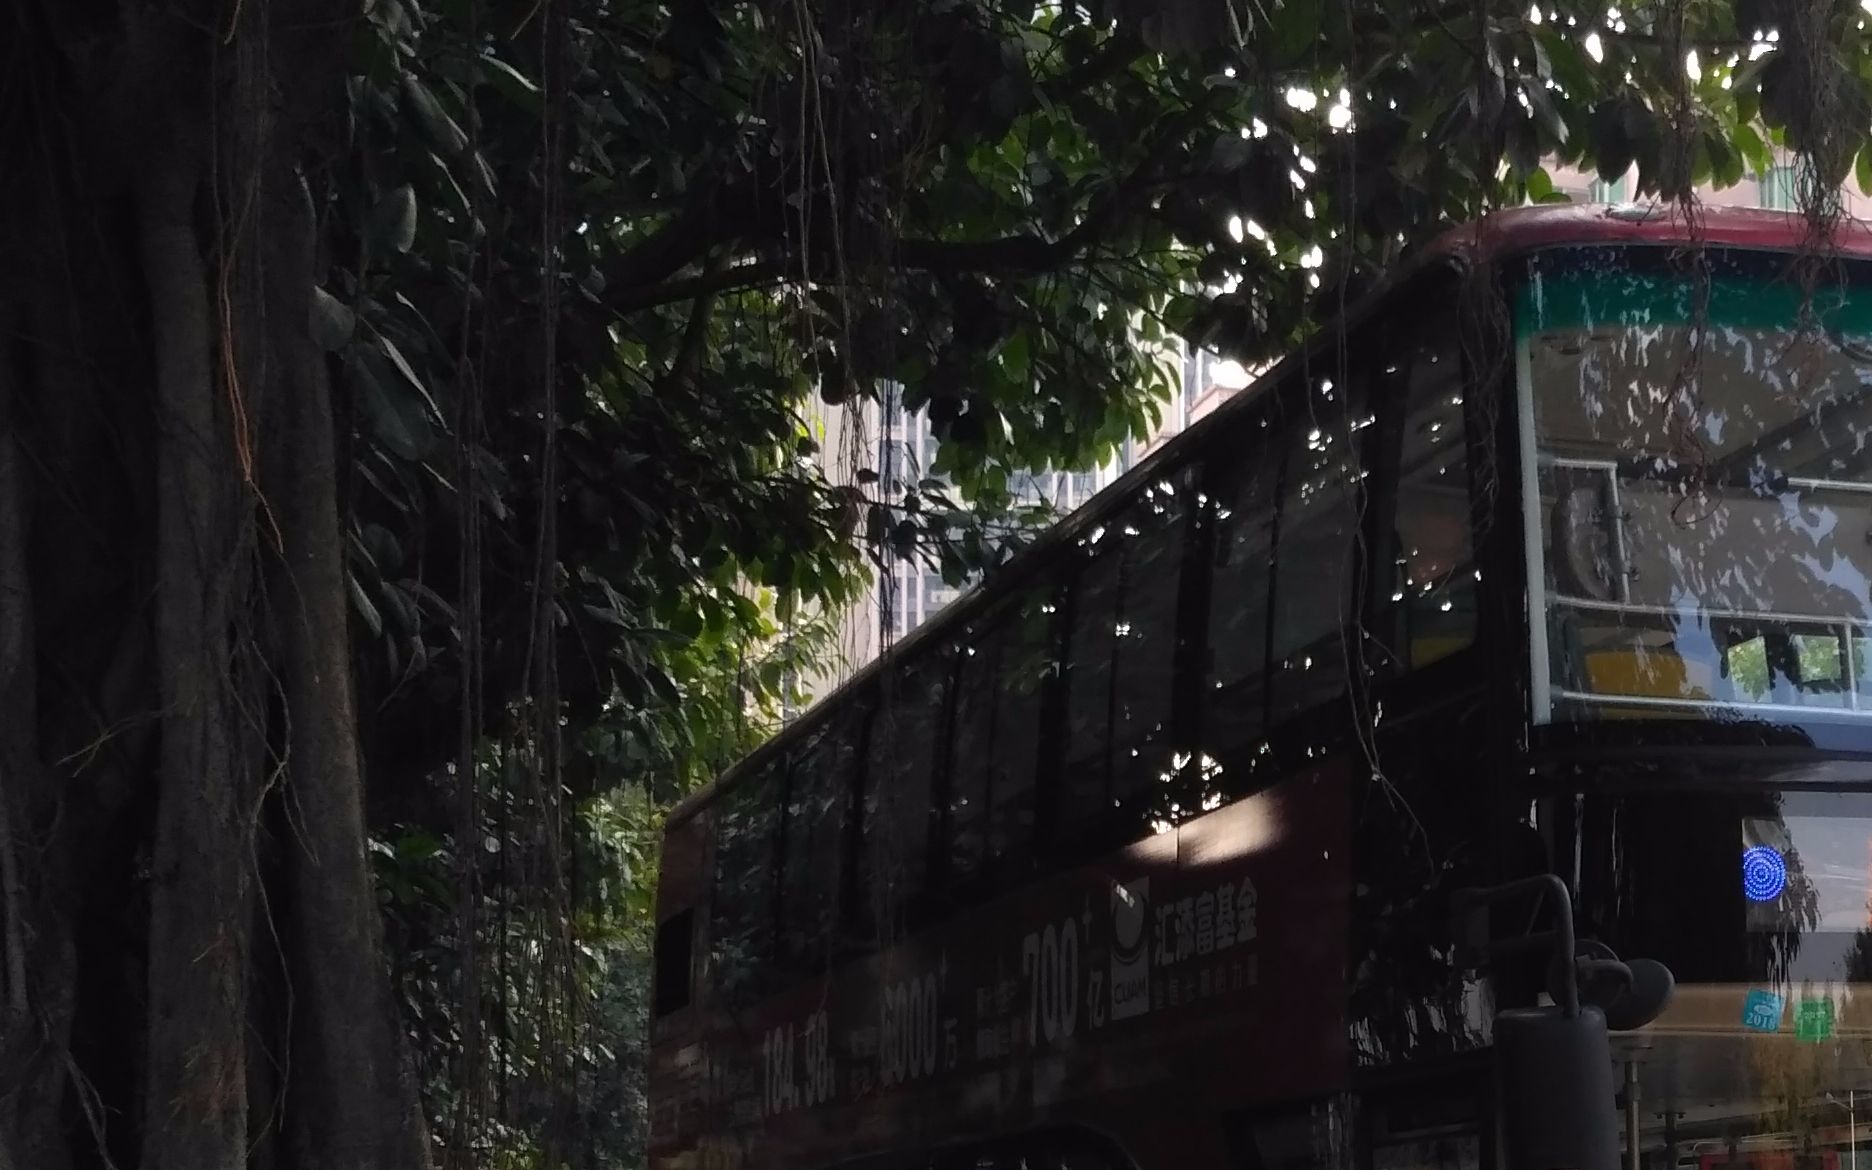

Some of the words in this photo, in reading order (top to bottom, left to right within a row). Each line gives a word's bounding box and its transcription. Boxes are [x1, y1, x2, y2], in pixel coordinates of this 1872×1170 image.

[1155, 875, 1258, 967] 汇添富基金
[1746, 1012, 1776, 1030] 2018
